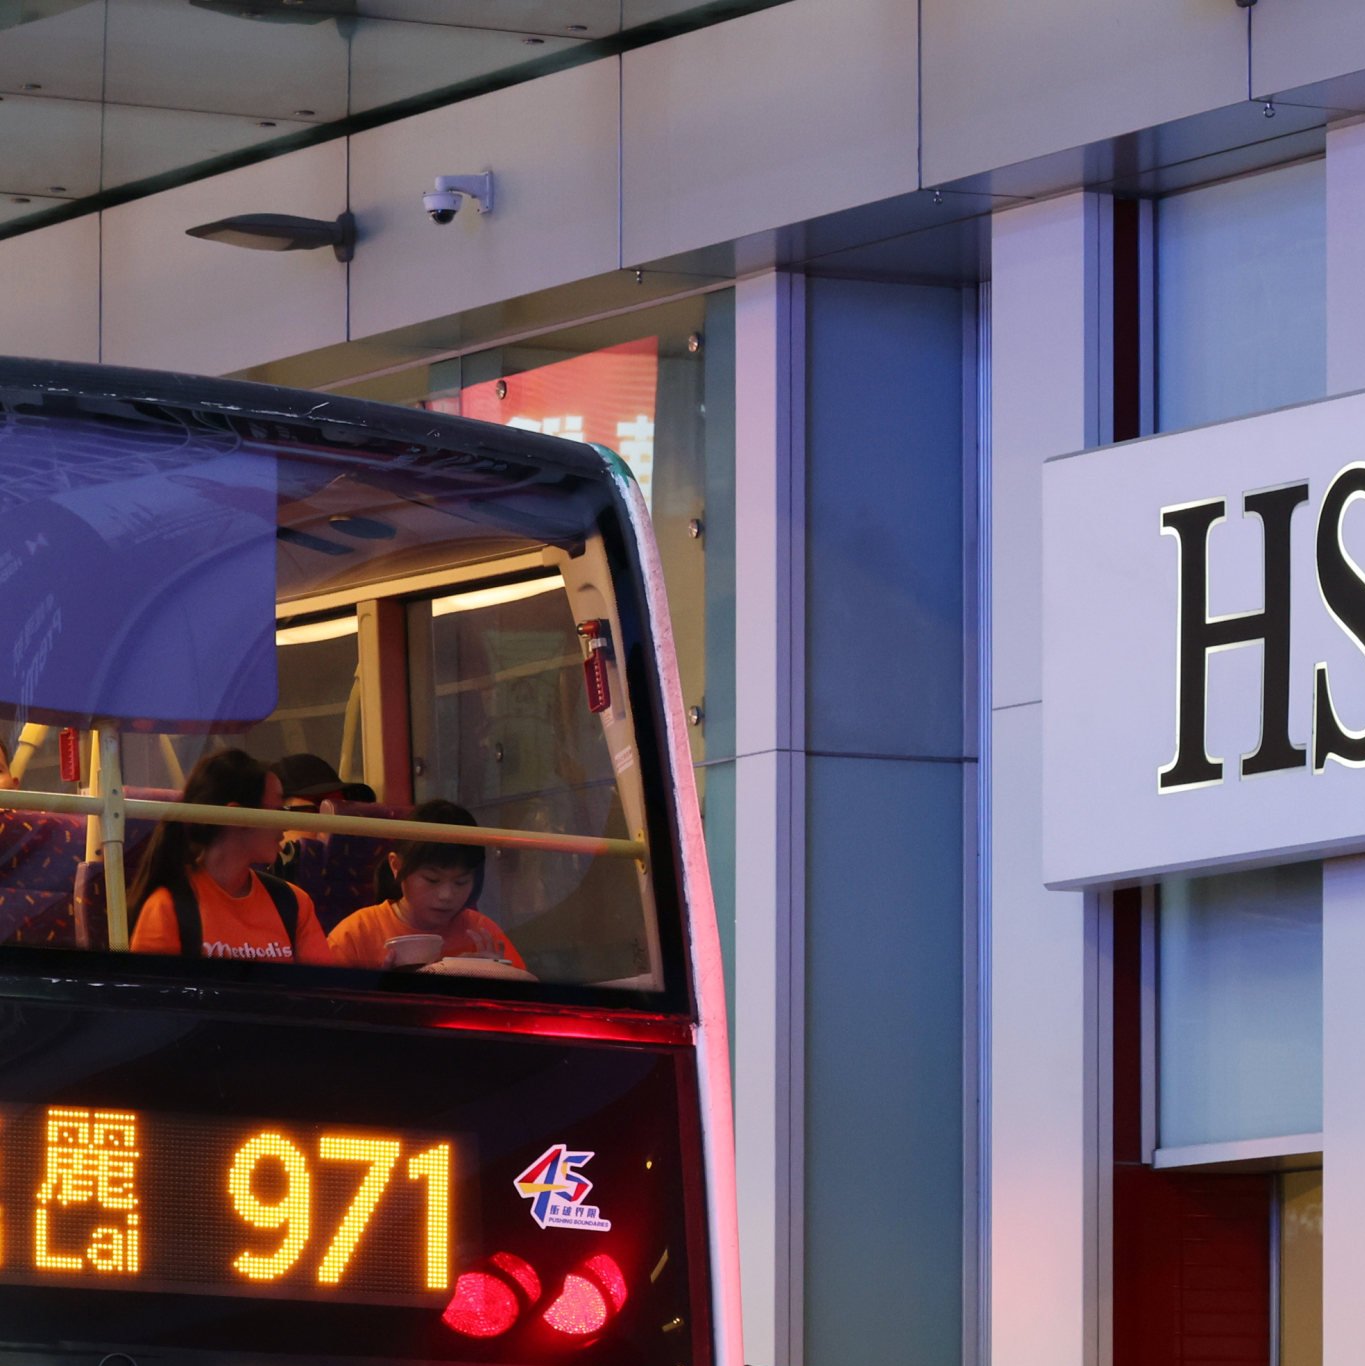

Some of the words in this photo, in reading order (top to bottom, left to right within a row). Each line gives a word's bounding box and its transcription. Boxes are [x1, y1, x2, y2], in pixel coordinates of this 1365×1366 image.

[37, 1109, 139, 1208] 麗
[36, 1208, 138, 1272] Lai
[228, 1133, 449, 1288] 971
[548, 1217, 573, 1225] PUSHING
[574, 1219, 609, 1228] BOUNDARIES
